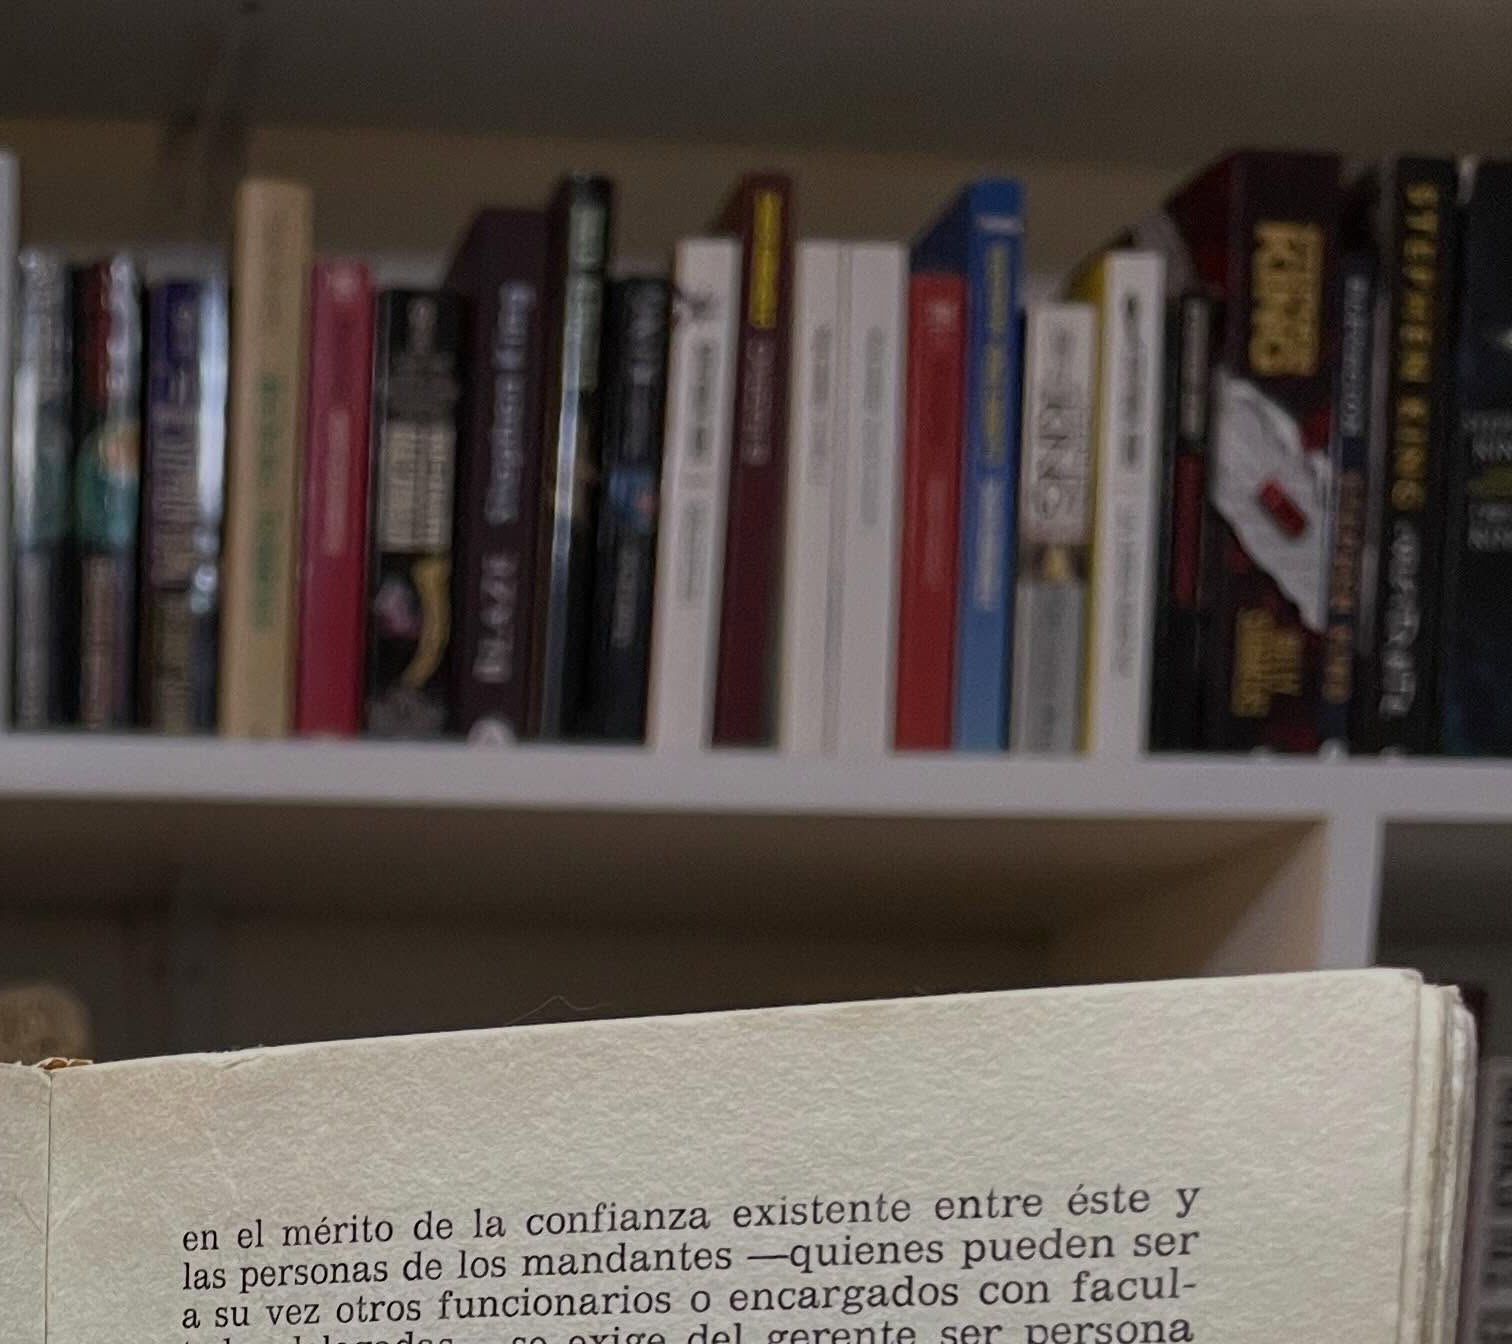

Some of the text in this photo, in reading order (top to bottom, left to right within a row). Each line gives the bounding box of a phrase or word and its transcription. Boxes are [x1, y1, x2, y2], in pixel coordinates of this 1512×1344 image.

[182, 1183, 1201, 1252] en el mérito de la confianza existente entre éste y
